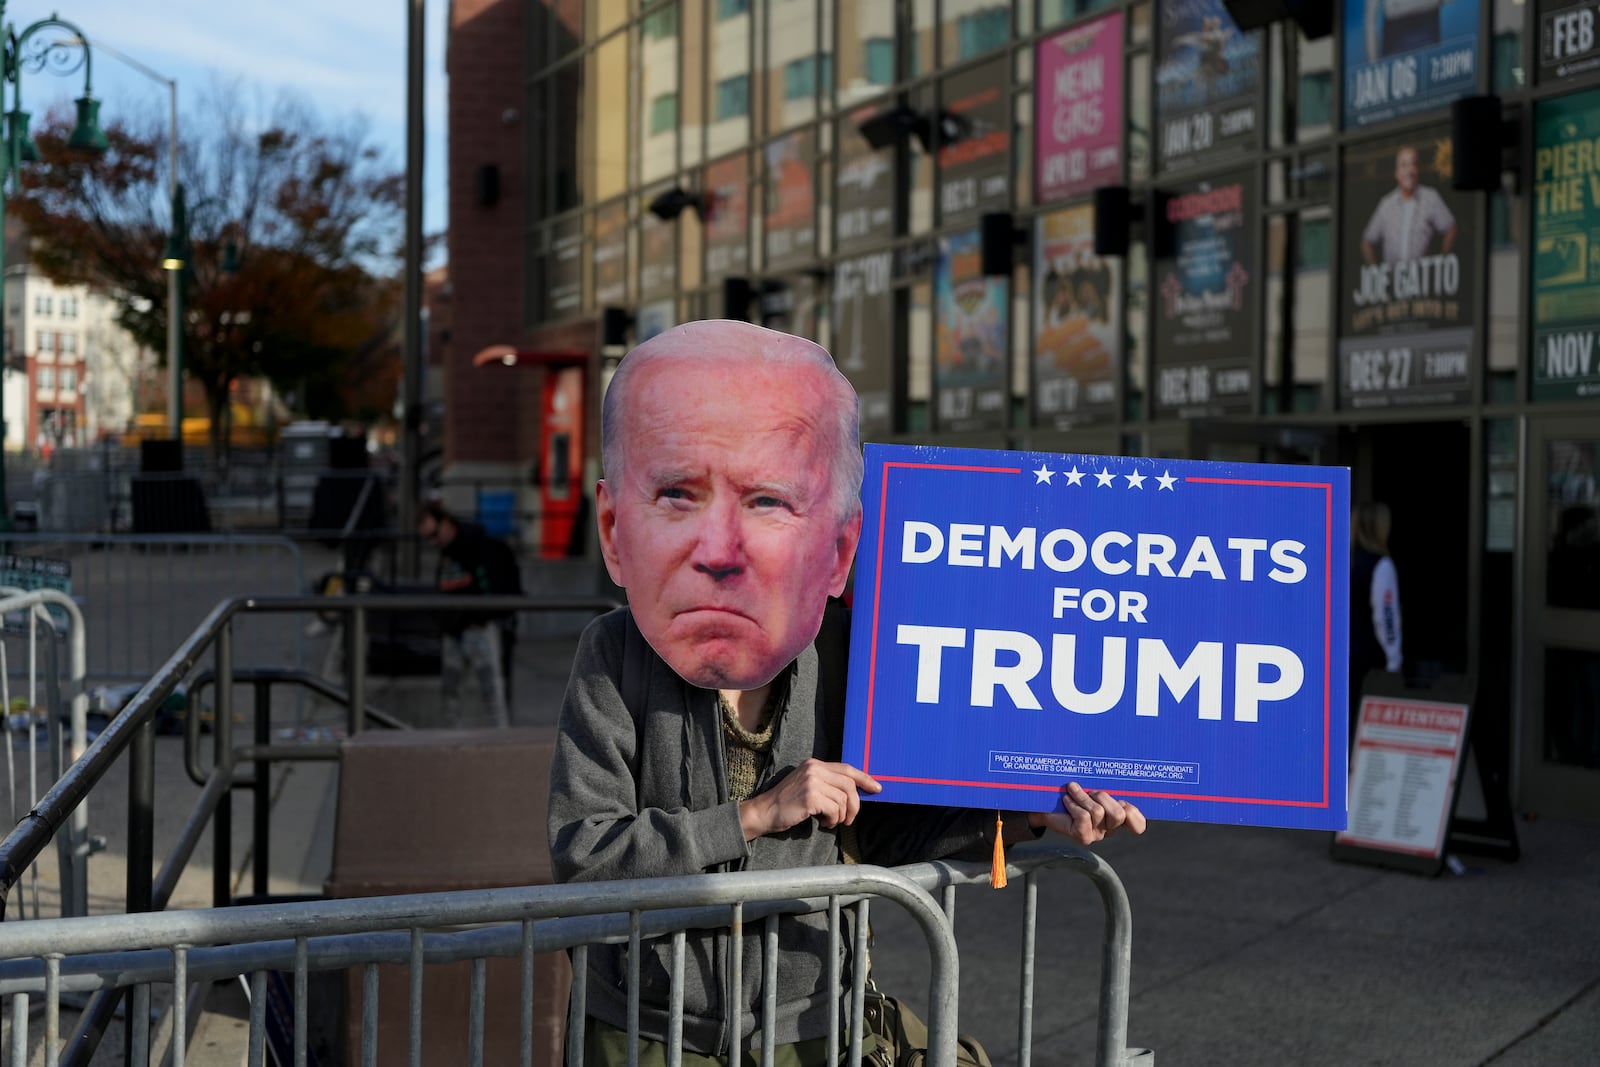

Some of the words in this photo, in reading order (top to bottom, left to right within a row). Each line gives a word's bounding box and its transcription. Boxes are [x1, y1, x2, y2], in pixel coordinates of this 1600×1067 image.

[1552, 8, 1595, 59] FEB
[1354, 63, 1389, 108] JAN
[1537, 178, 1584, 215] THE
[1353, 263, 1390, 305] JOE
[1393, 253, 1459, 299] GATTO
[1349, 350, 1385, 391] DEC
[1386, 347, 1412, 388] 27
[1547, 331, 1593, 378] NOV
[901, 520, 1307, 584] DEMOCRATS
[1053, 587, 1147, 623] FOR
[896, 624, 1305, 723] TRUMP
[995, 754, 1009, 763] PAID
[1010, 755, 1023, 764] FOR
[1025, 756, 1034, 764] BY
[1034, 757, 1062, 766] AMERICA
[1079, 760, 1092, 768] NOT
[1093, 761, 1133, 770] AUTHORIZED
[1134, 763, 1143, 771] BY
[1143, 764, 1157, 772] ANY
[1158, 764, 1194, 774] CANDIDATE
[1014, 763, 1055, 773] CANDIDATE'S
